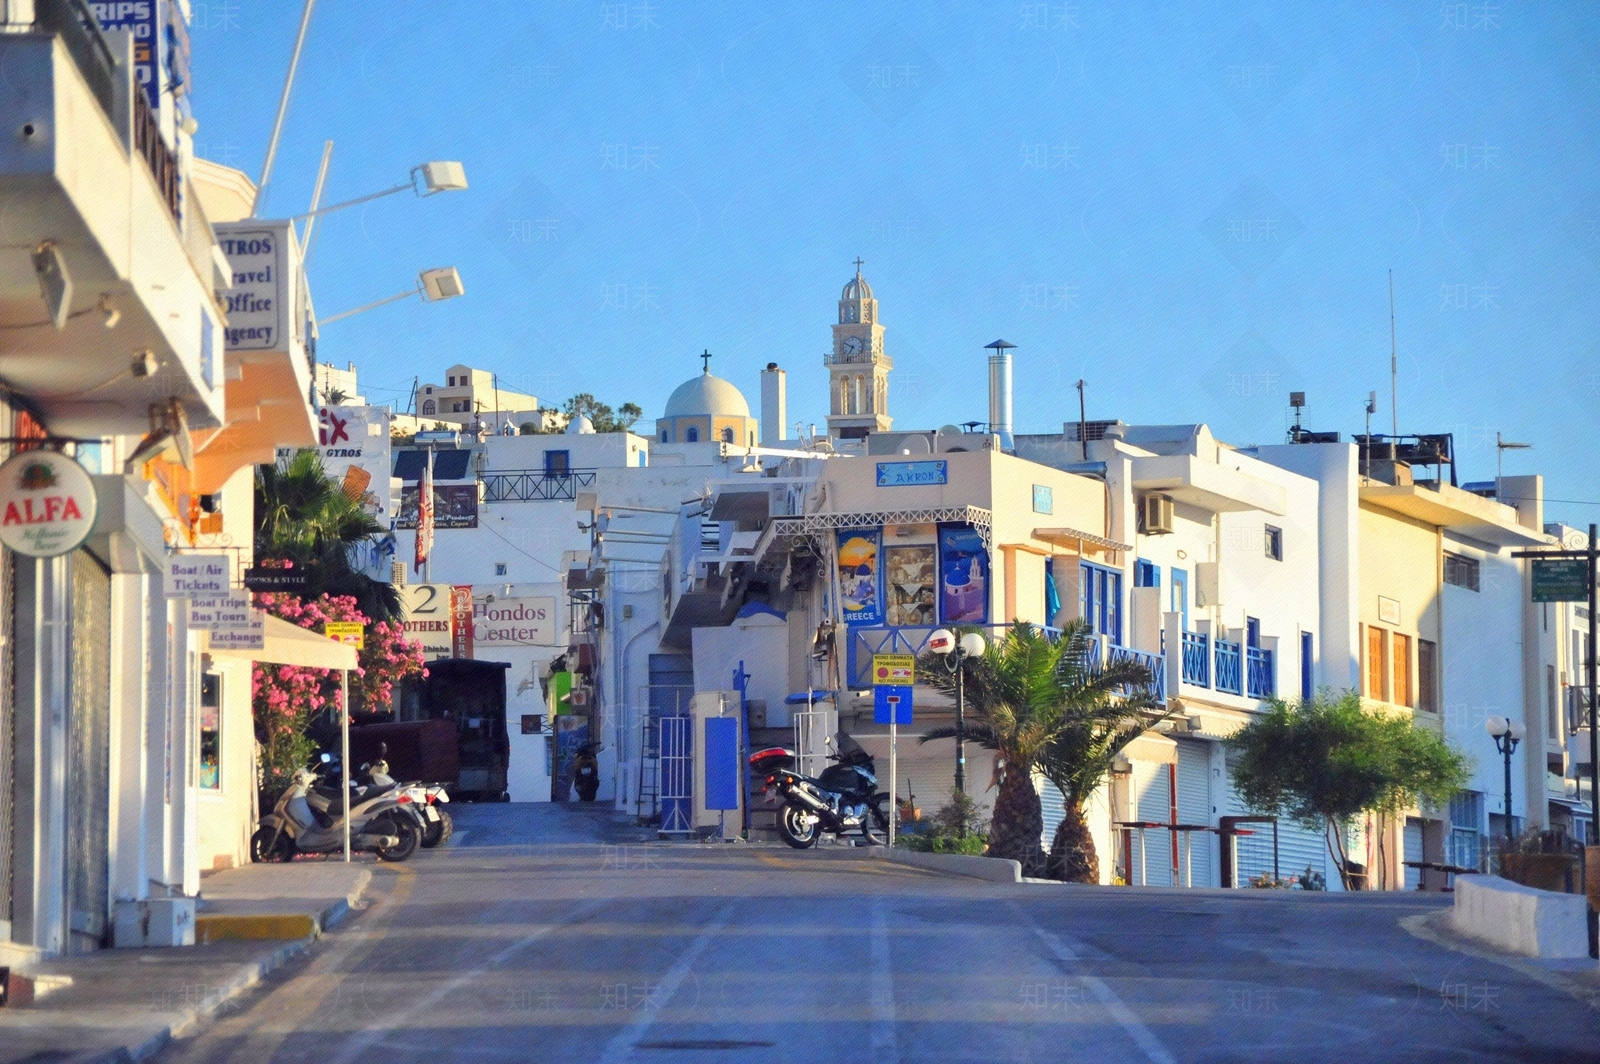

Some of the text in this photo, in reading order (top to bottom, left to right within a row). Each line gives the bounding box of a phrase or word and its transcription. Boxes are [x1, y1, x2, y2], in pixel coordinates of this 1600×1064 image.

[221, 239, 271, 255] TROS
[327, 449, 362, 457] GYROS
[896, 473, 934, 483] AKRON
[2, 495, 82, 526] ALFA
[172, 565, 197, 575] Boat
[206, 564, 223, 575] Air
[174, 579, 220, 590] Tickets
[411, 585, 437, 613] 2
[192, 612, 246, 621] Bus Tours
[473, 603, 546, 621] Hondos
[212, 632, 262, 643] Exchange
[473, 624, 539, 641] Center
